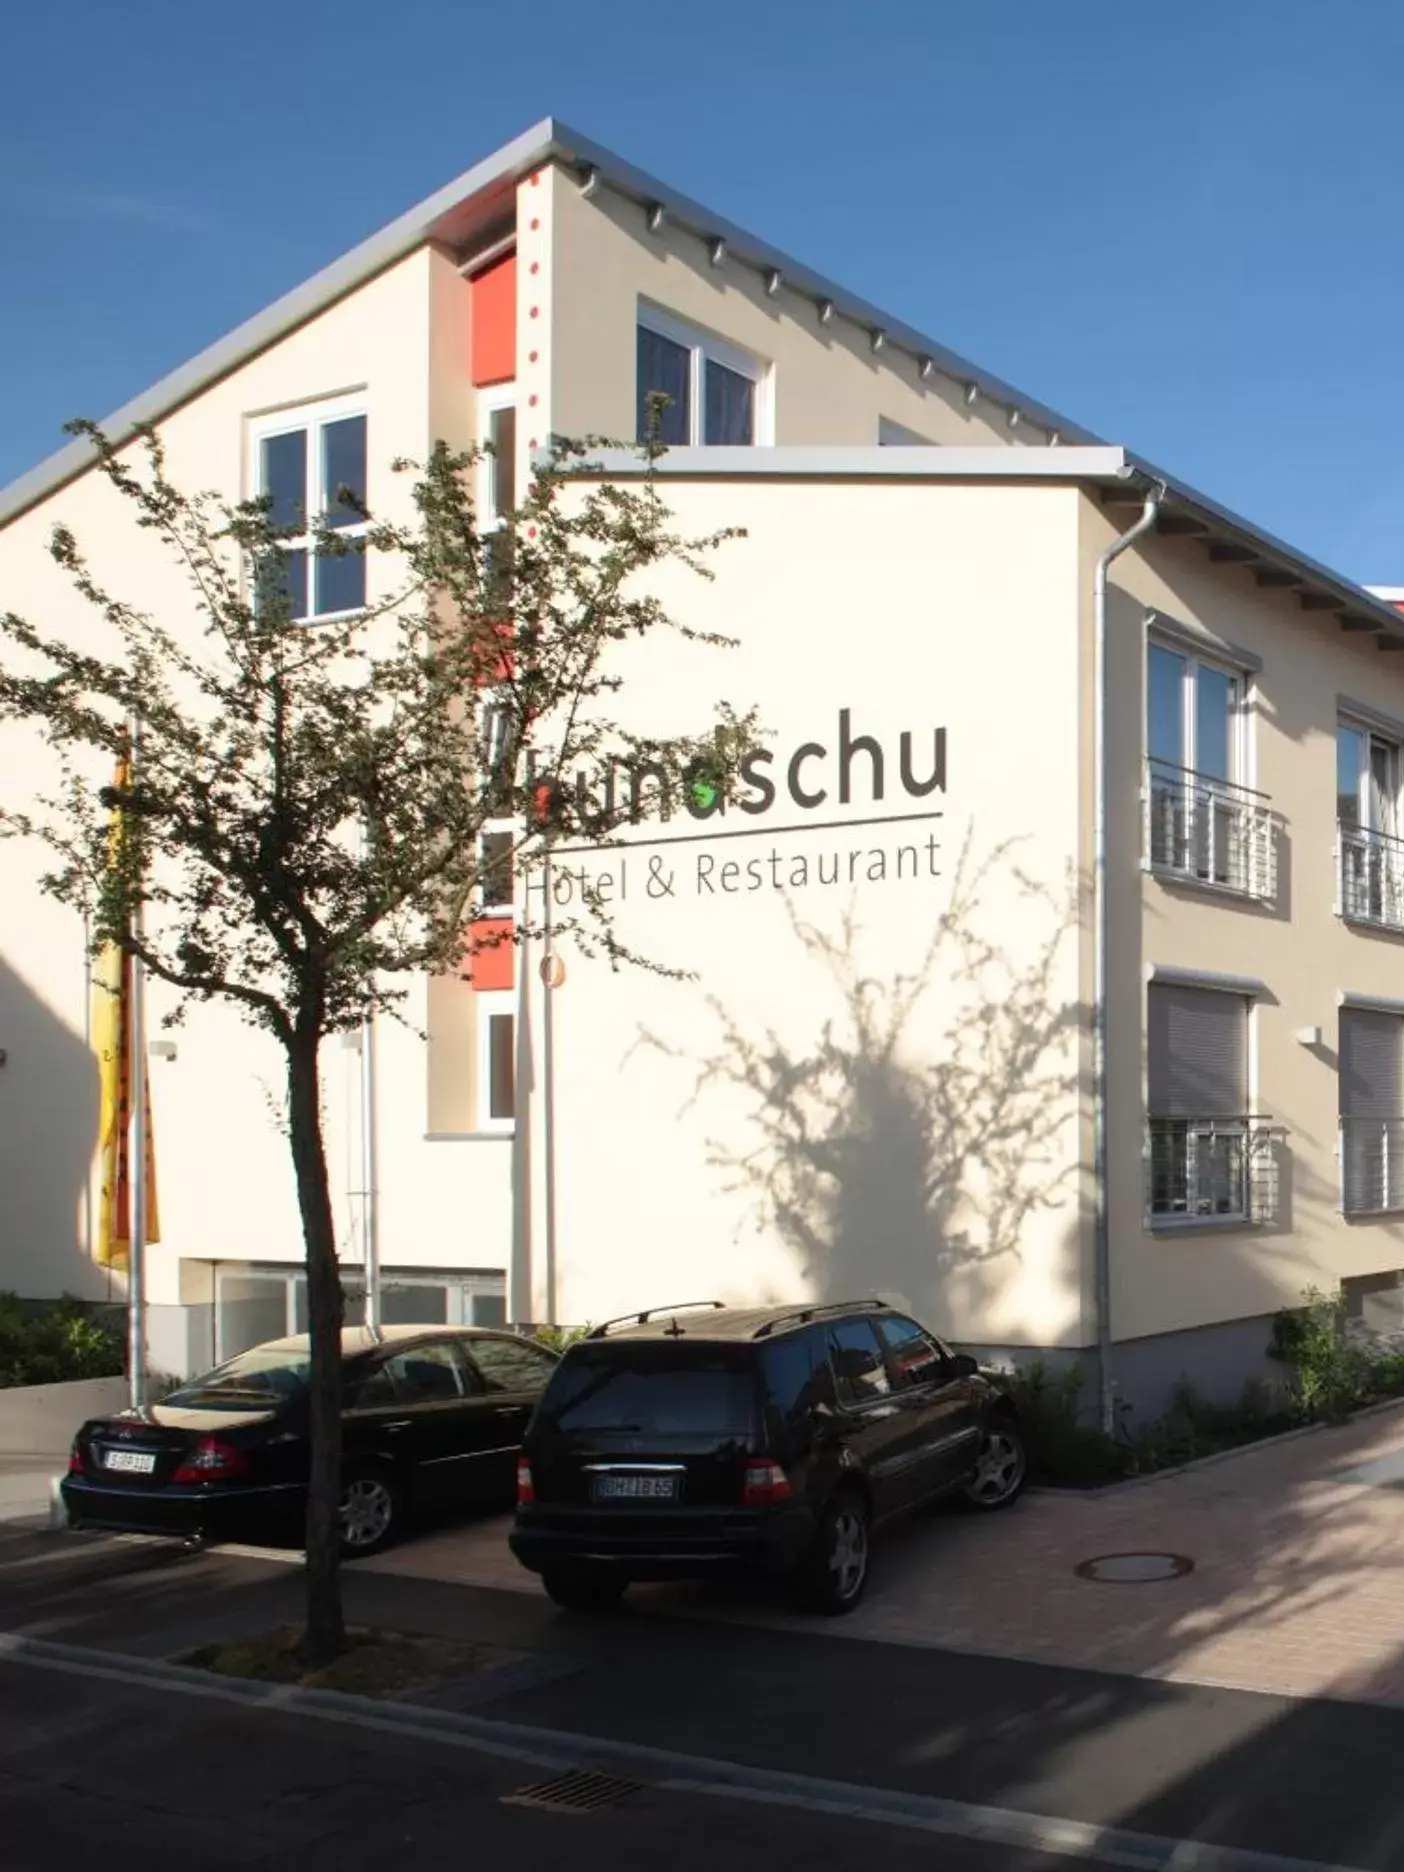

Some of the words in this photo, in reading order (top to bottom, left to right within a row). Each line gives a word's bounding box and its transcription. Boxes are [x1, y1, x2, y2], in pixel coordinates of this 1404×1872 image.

[526, 857, 627, 906] Hotel
[646, 855, 675, 899] &
[697, 833, 942, 895] Restaurant
